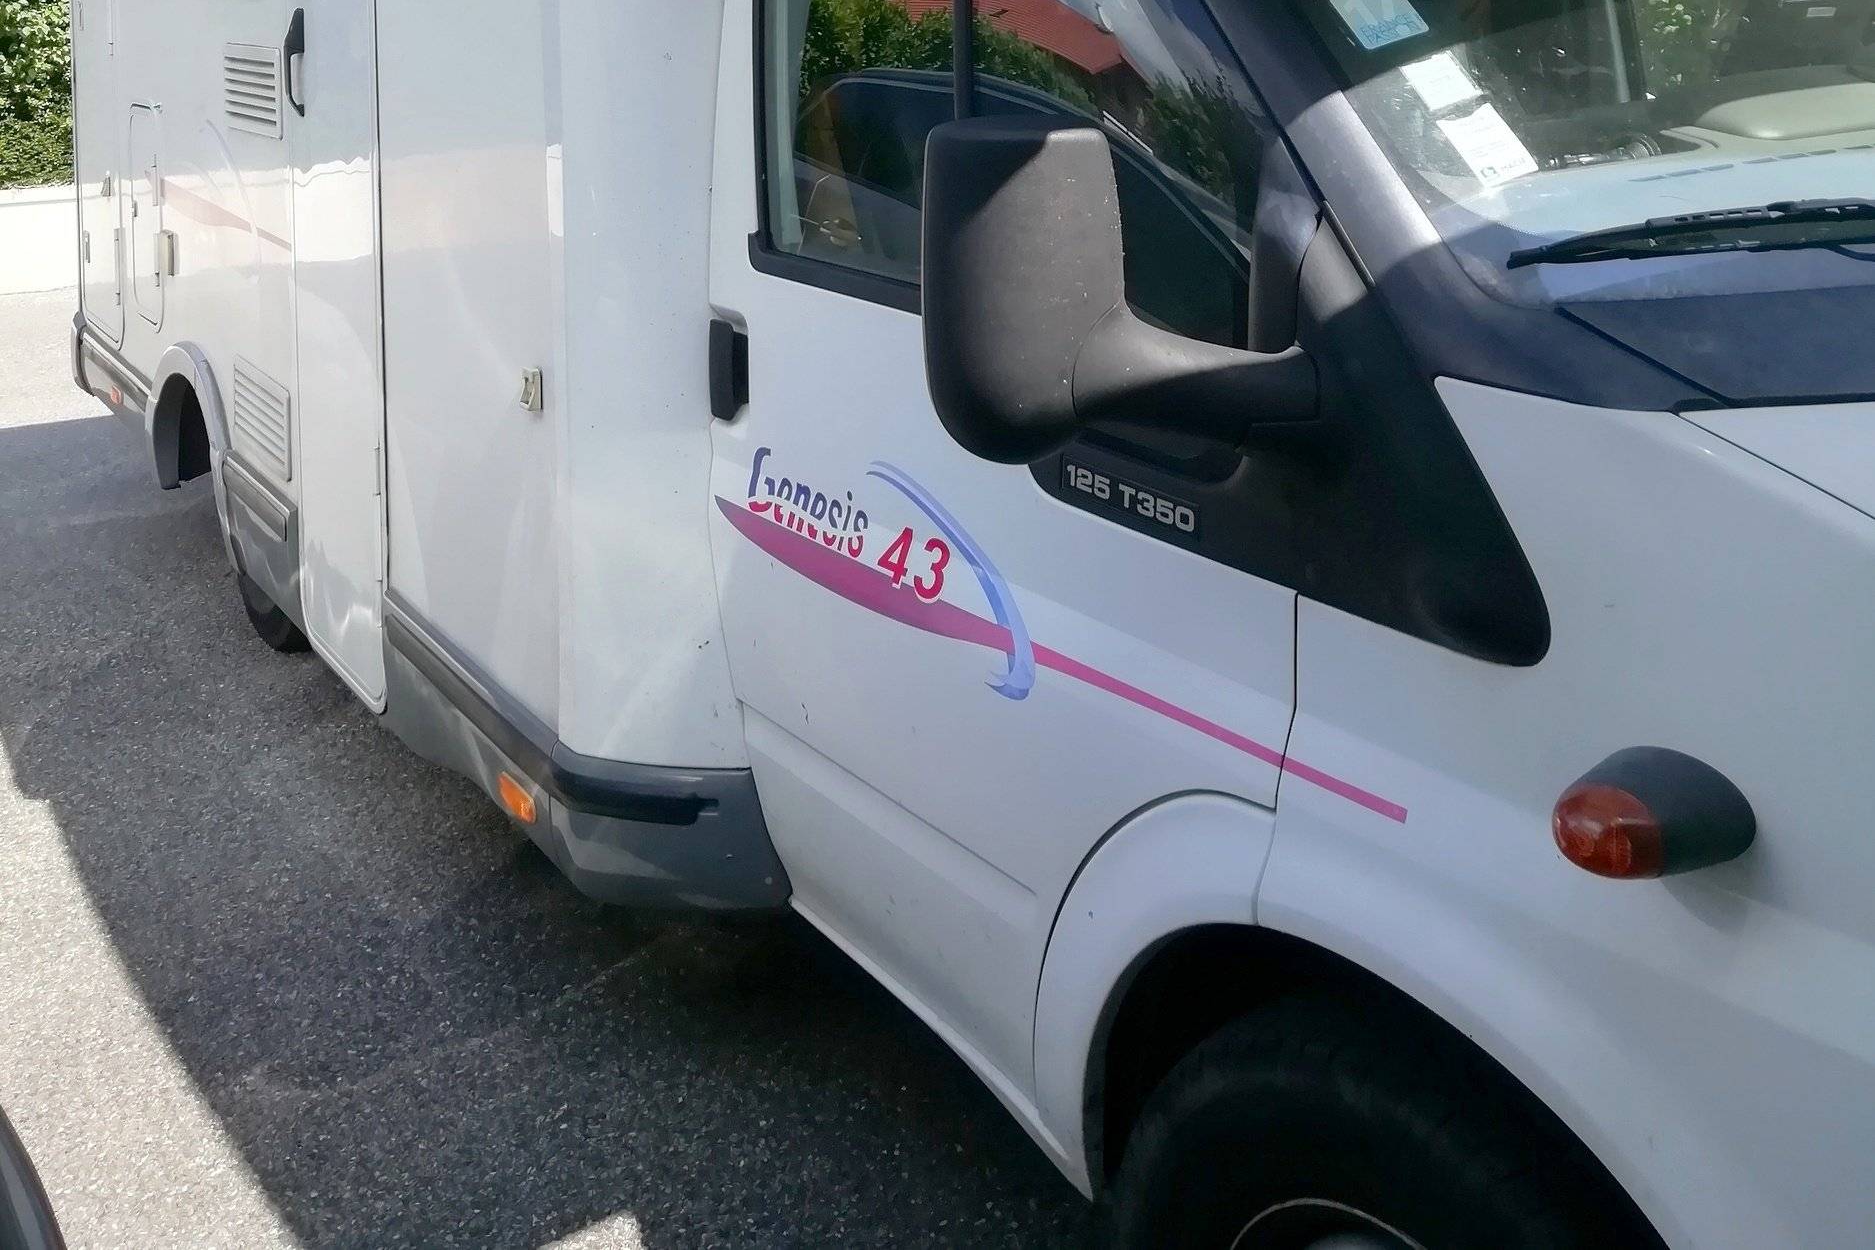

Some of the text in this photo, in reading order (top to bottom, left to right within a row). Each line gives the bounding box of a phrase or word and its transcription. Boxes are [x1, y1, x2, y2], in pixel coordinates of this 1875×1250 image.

[748, 446, 951, 600] Genesis 43
[1066, 464, 1195, 532] 125 T350
